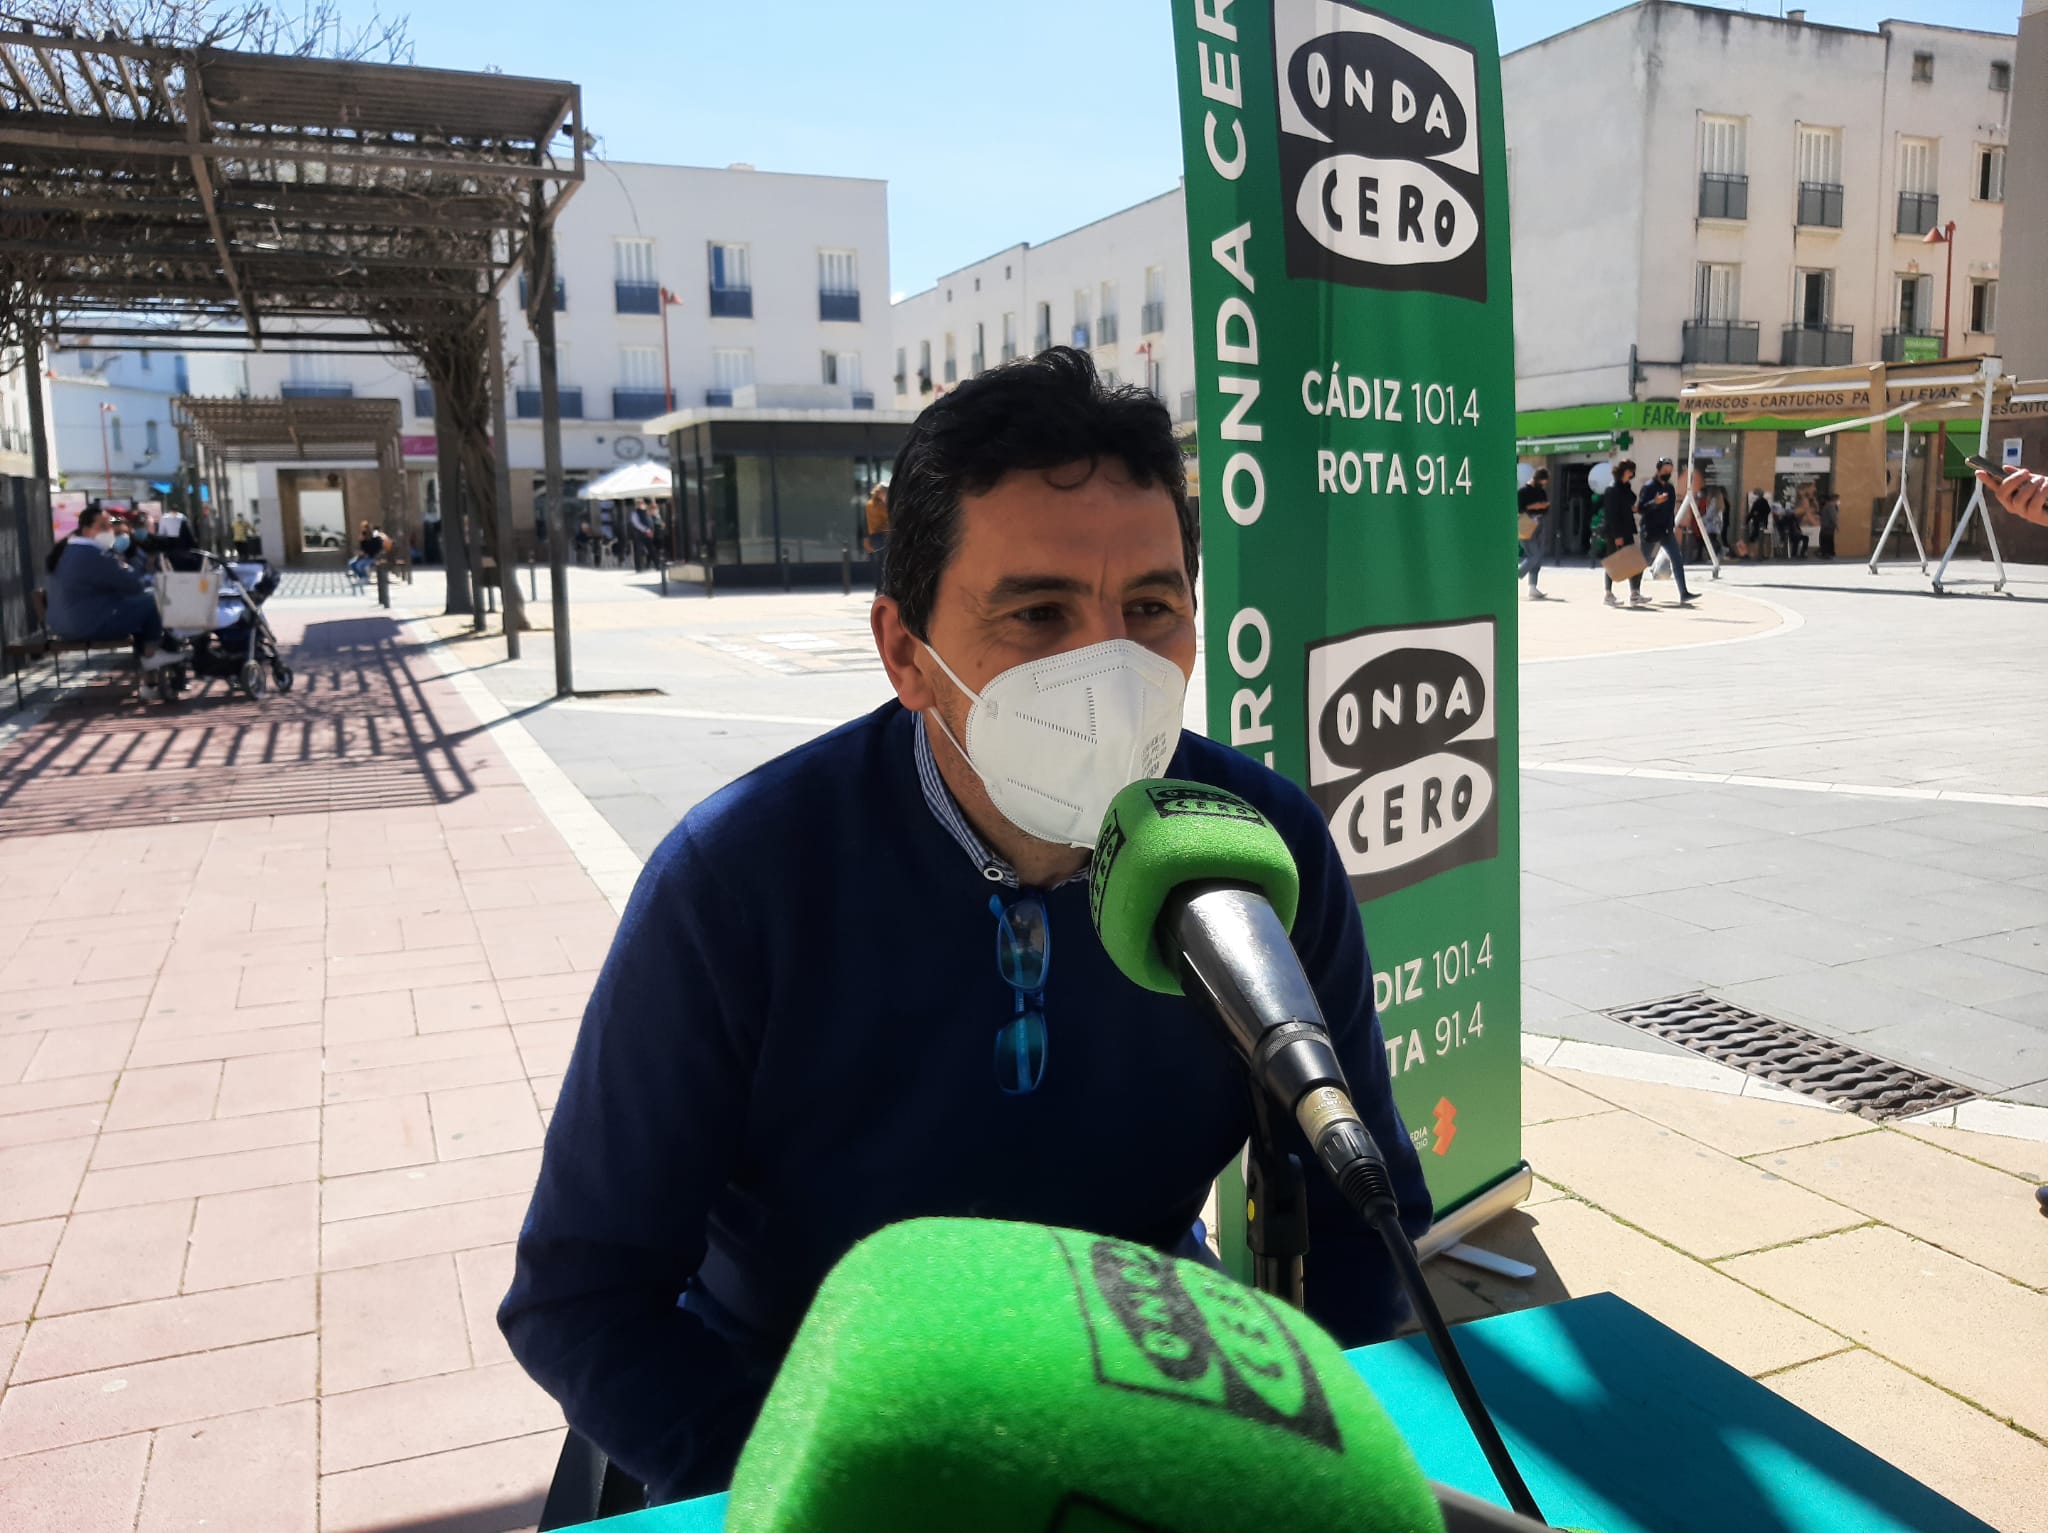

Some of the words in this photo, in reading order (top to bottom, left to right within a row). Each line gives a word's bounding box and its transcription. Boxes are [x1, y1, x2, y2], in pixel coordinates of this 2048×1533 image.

[1306, 52, 1451, 139] ONDA
[1322, 169, 1456, 248] CERO
[1211, 221, 1265, 526] ONDA
[1301, 361, 1402, 422] CÁDIZ
[1411, 382, 1480, 427] 101.4
[1684, 397, 1749, 409] MARISCOS
[1760, 393, 1844, 407] CARTUCHOS
[1901, 386, 1960, 402] LLEVAR
[1317, 449, 1408, 495] ROTA
[1416, 455, 1472, 496] 91.4
[1227, 607, 1274, 770] RO
[1336, 676, 1471, 746] ONDA
[1347, 774, 1473, 854] CERO
[1372, 957, 1424, 1013] DIZ
[1432, 932, 1493, 989] 101.4
[1435, 1001, 1484, 1056] 91.4
